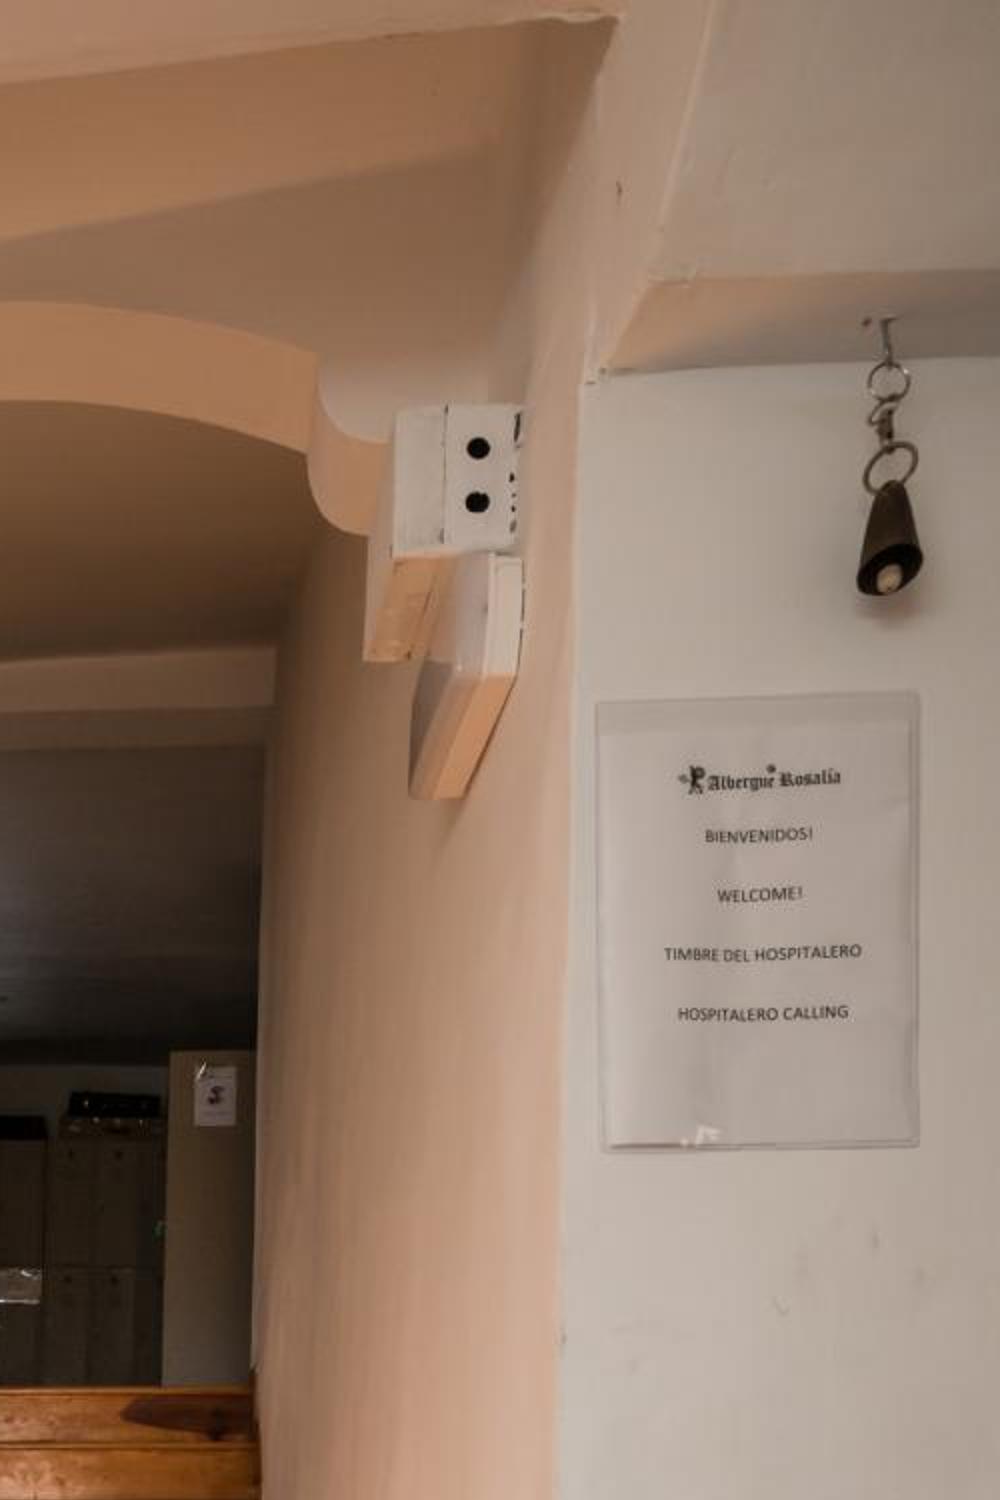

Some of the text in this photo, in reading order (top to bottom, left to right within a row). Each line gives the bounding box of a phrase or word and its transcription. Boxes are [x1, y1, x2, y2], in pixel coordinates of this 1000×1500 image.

[707, 774, 775, 792] Albergue
[705, 826, 813, 844] BIENVENIDOS!
[716, 885, 802, 902] WELCOME!
[664, 943, 862, 963] TIMBRE DEL HOSPITALERO
[678, 1004, 849, 1022] HOSPITALERO CALLING
